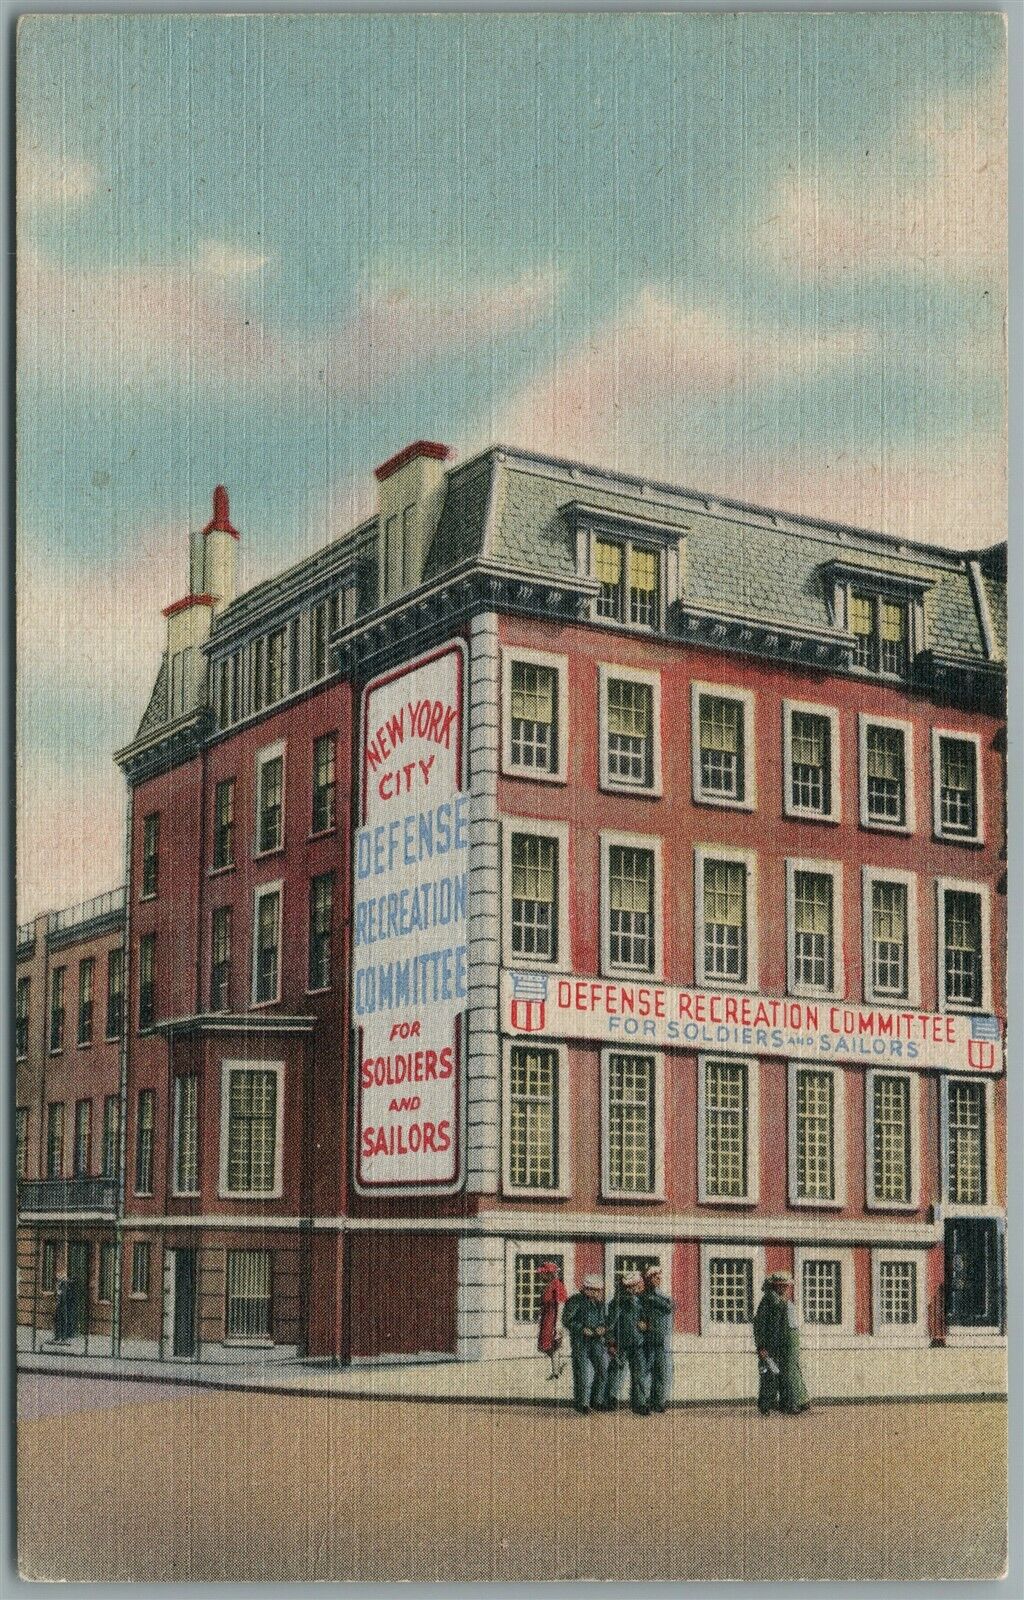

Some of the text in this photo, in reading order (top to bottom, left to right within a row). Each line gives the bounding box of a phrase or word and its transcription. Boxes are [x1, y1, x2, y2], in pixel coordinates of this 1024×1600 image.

[367, 700, 458, 771] NEW YORK
[378, 755, 435, 800] CITY
[357, 797, 468, 880] DEFENSE
[356, 872, 468, 946] RECREATION
[356, 945, 468, 1016] COMMITTEE
[389, 1021, 421, 1041] FOR
[558, 981, 956, 1043] DEFENSE RECREATION COMMITTEE
[608, 1016, 919, 1058] FOR SOLDIERS AND SAILORS
[362, 1047, 453, 1089] SOLDIERS
[388, 1096, 421, 1112] AND
[363, 1120, 451, 1157] SAILORS
